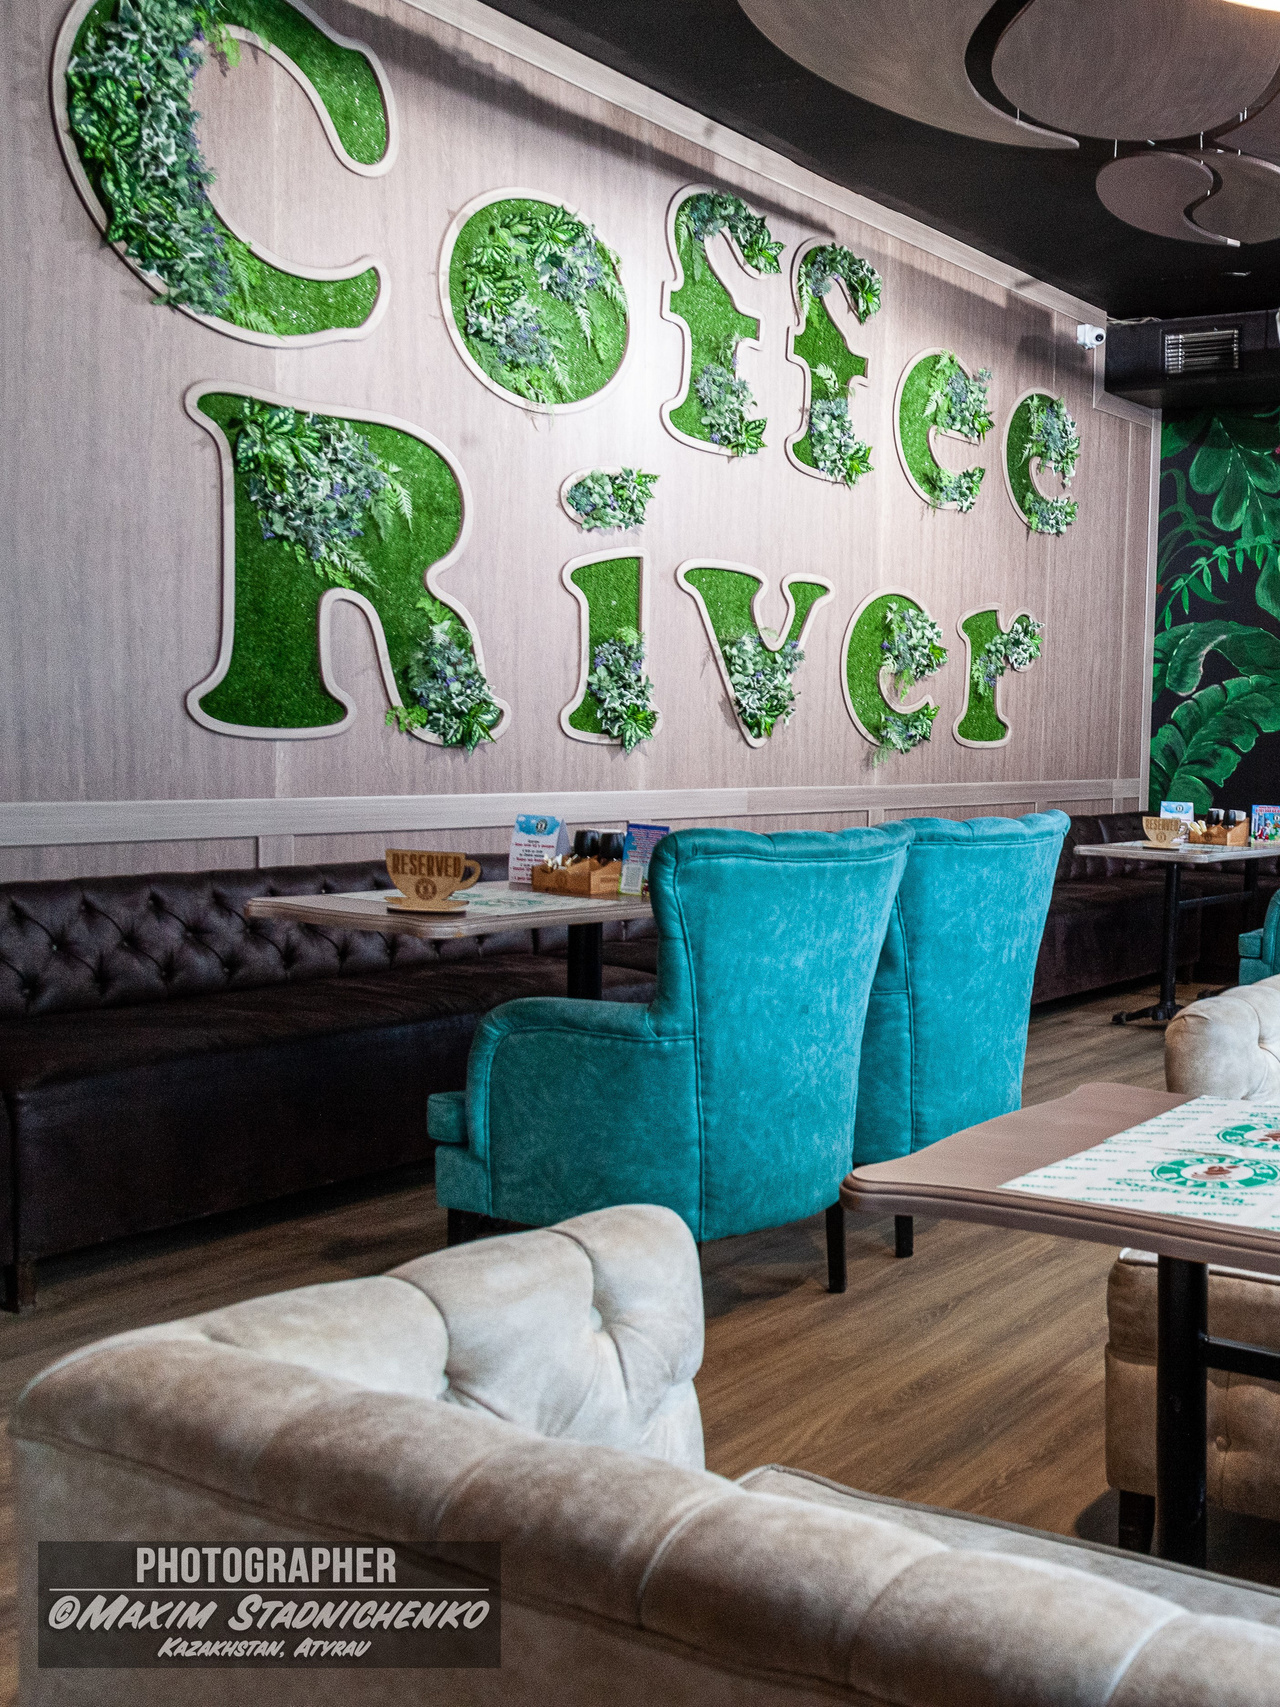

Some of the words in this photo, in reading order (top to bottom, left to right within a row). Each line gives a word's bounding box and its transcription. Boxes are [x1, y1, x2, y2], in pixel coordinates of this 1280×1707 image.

[52, 0, 1080, 535] Coffee
[185, 380, 1044, 757] River
[392, 852, 462, 878] RESERVED
[1145, 818, 1179, 831] RESERVED
